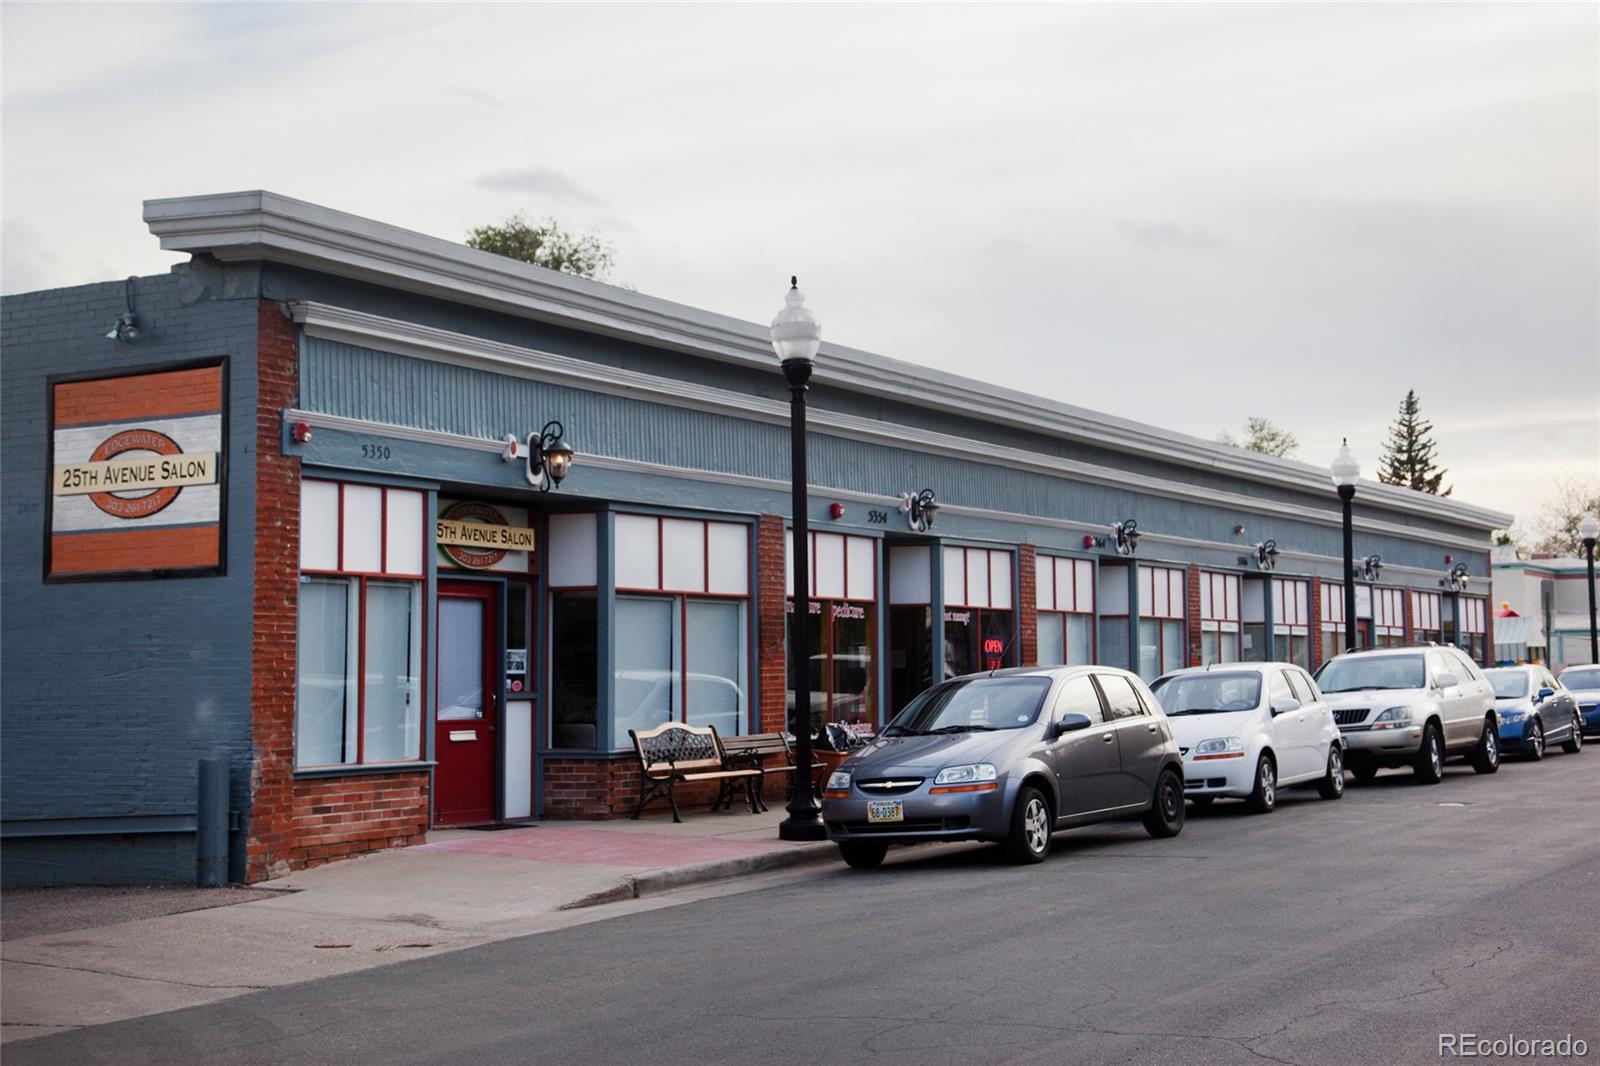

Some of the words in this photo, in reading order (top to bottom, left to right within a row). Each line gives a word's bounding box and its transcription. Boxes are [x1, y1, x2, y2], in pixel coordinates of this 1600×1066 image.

[105, 434, 165, 455] EDGEWATER
[361, 444, 391, 460] 5350
[62, 468, 98, 488] 25TH
[103, 465, 156, 485] AVENUE
[161, 460, 206, 480] SALON
[437, 523, 457, 539] 5TH
[460, 525, 498, 543] AVENUE
[500, 529, 532, 546] SALON
[832, 602, 865, 622] pedicure
[984, 639, 1003, 653] OPEN
